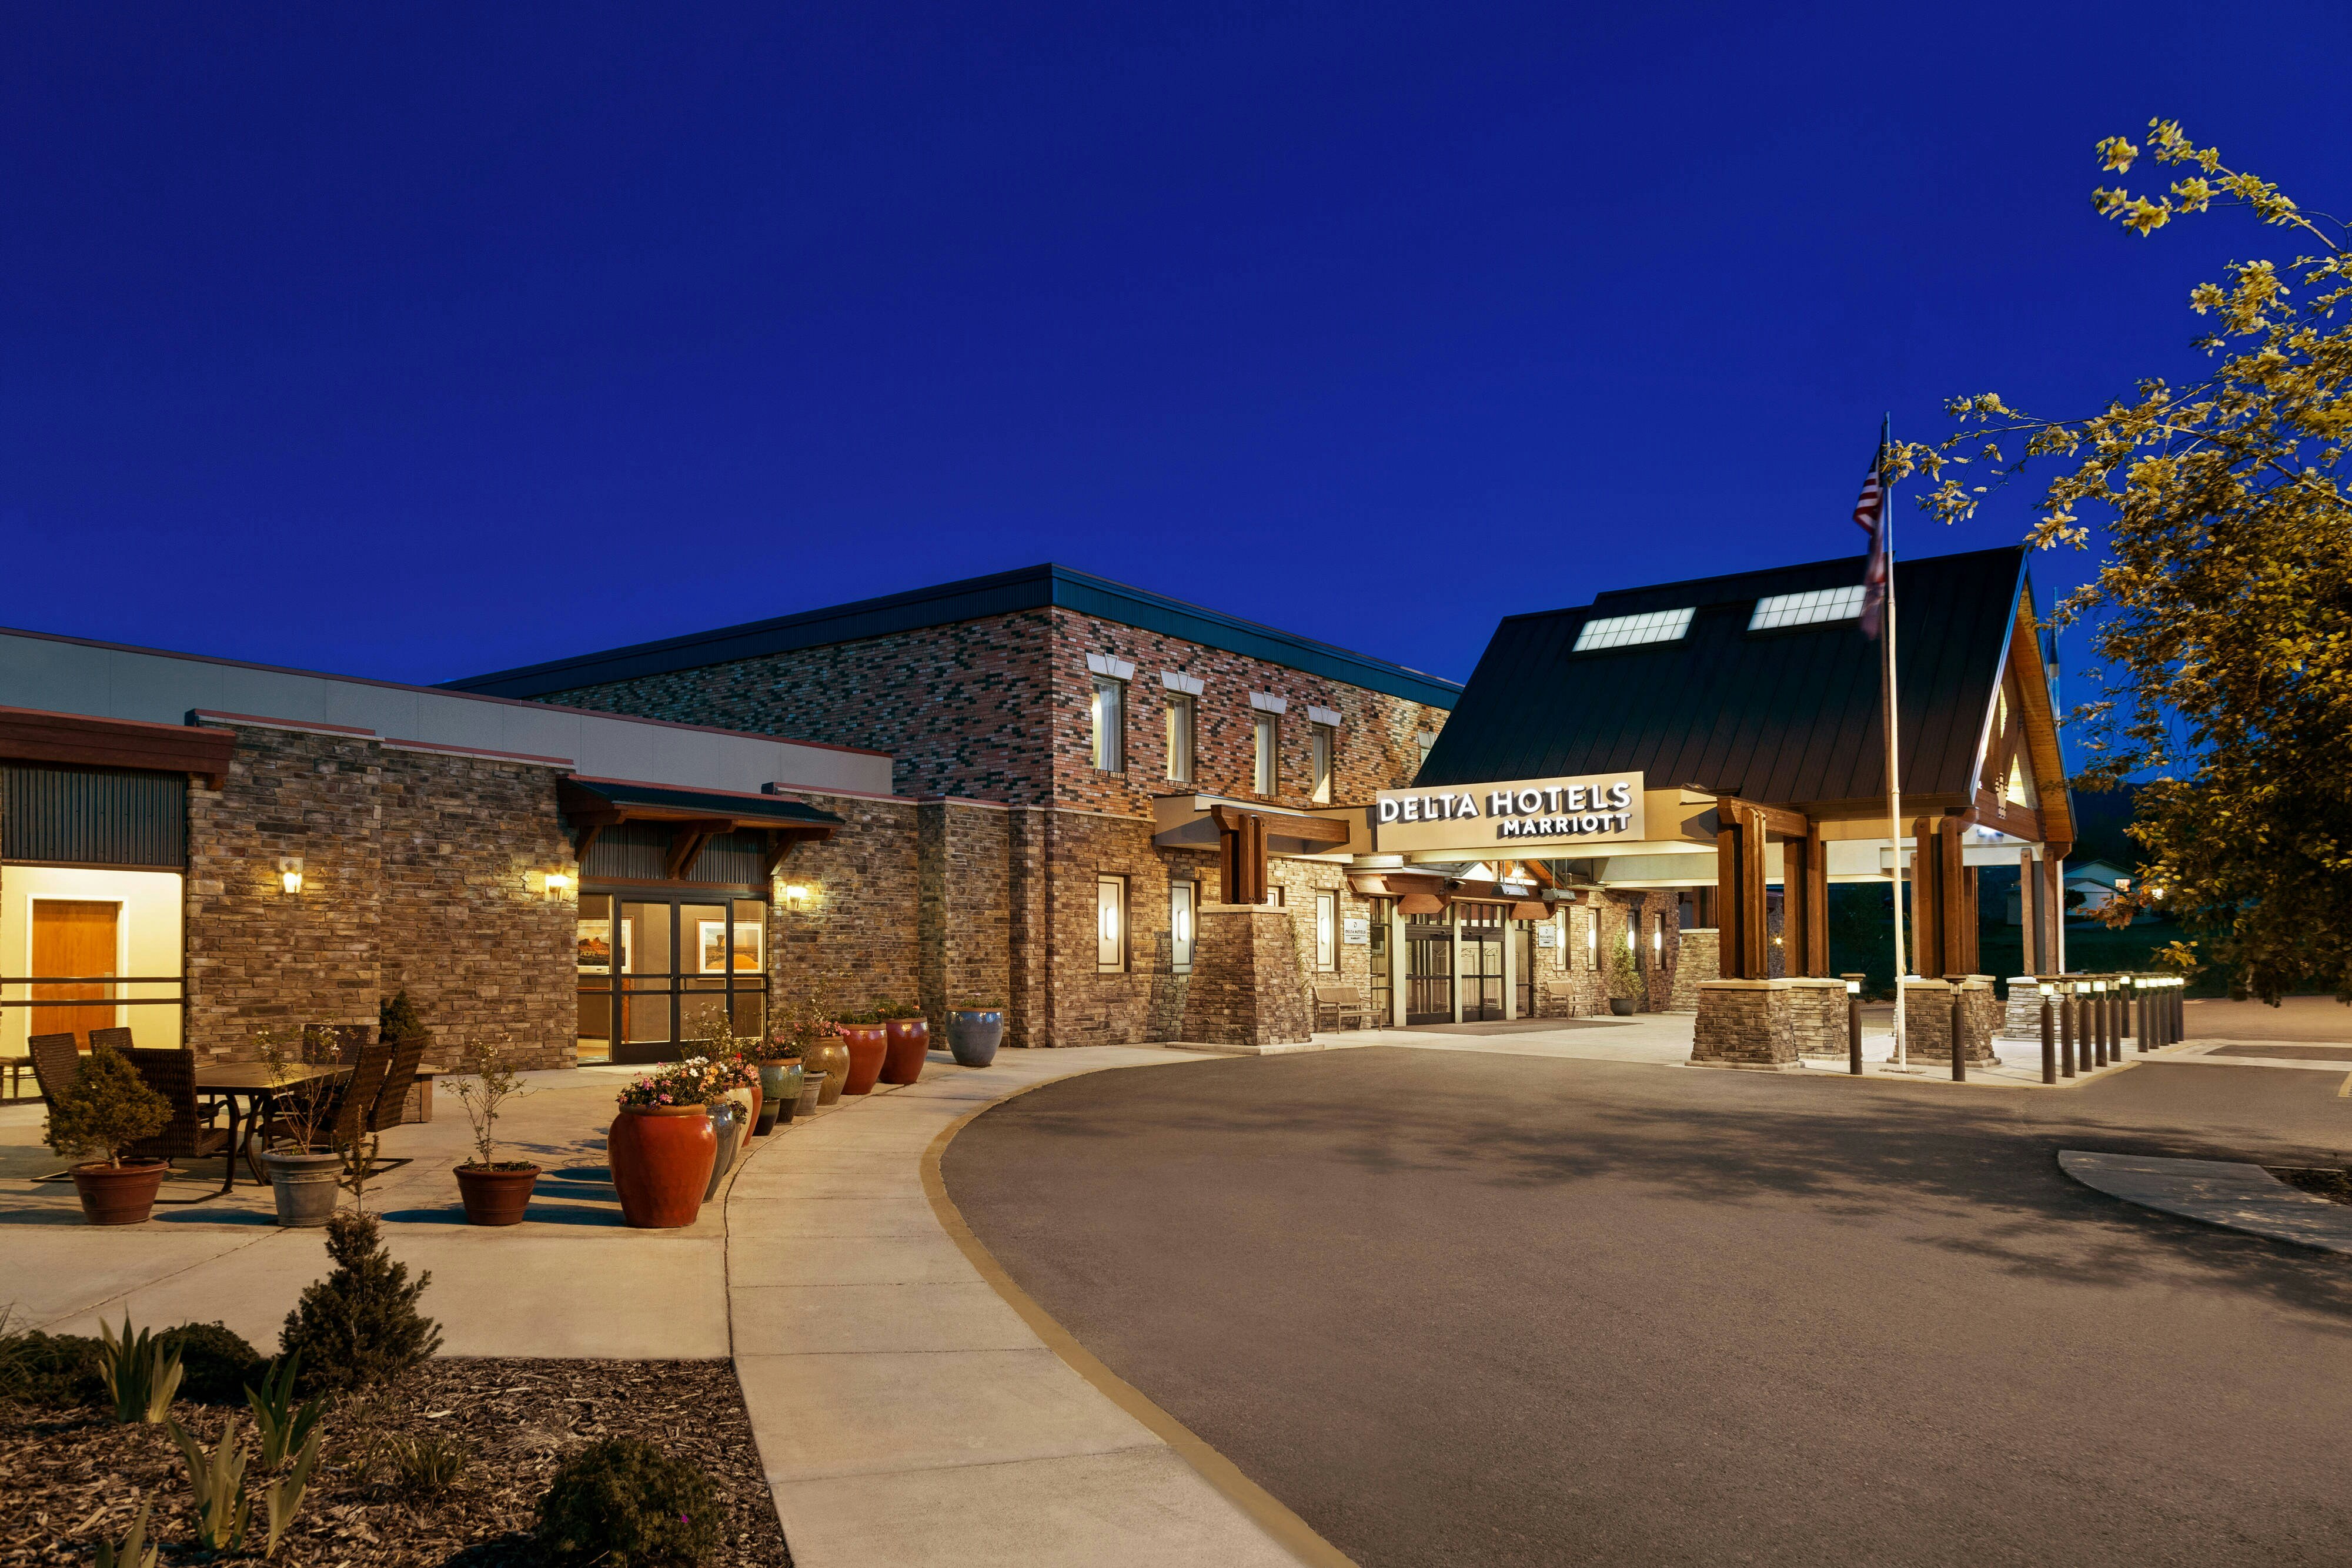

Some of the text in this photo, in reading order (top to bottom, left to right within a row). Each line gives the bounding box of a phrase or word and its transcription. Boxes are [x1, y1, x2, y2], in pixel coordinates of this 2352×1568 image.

[1380, 783, 1631, 821] DELTA HOTELS
[1504, 814, 1631, 835] MARRIOTT
